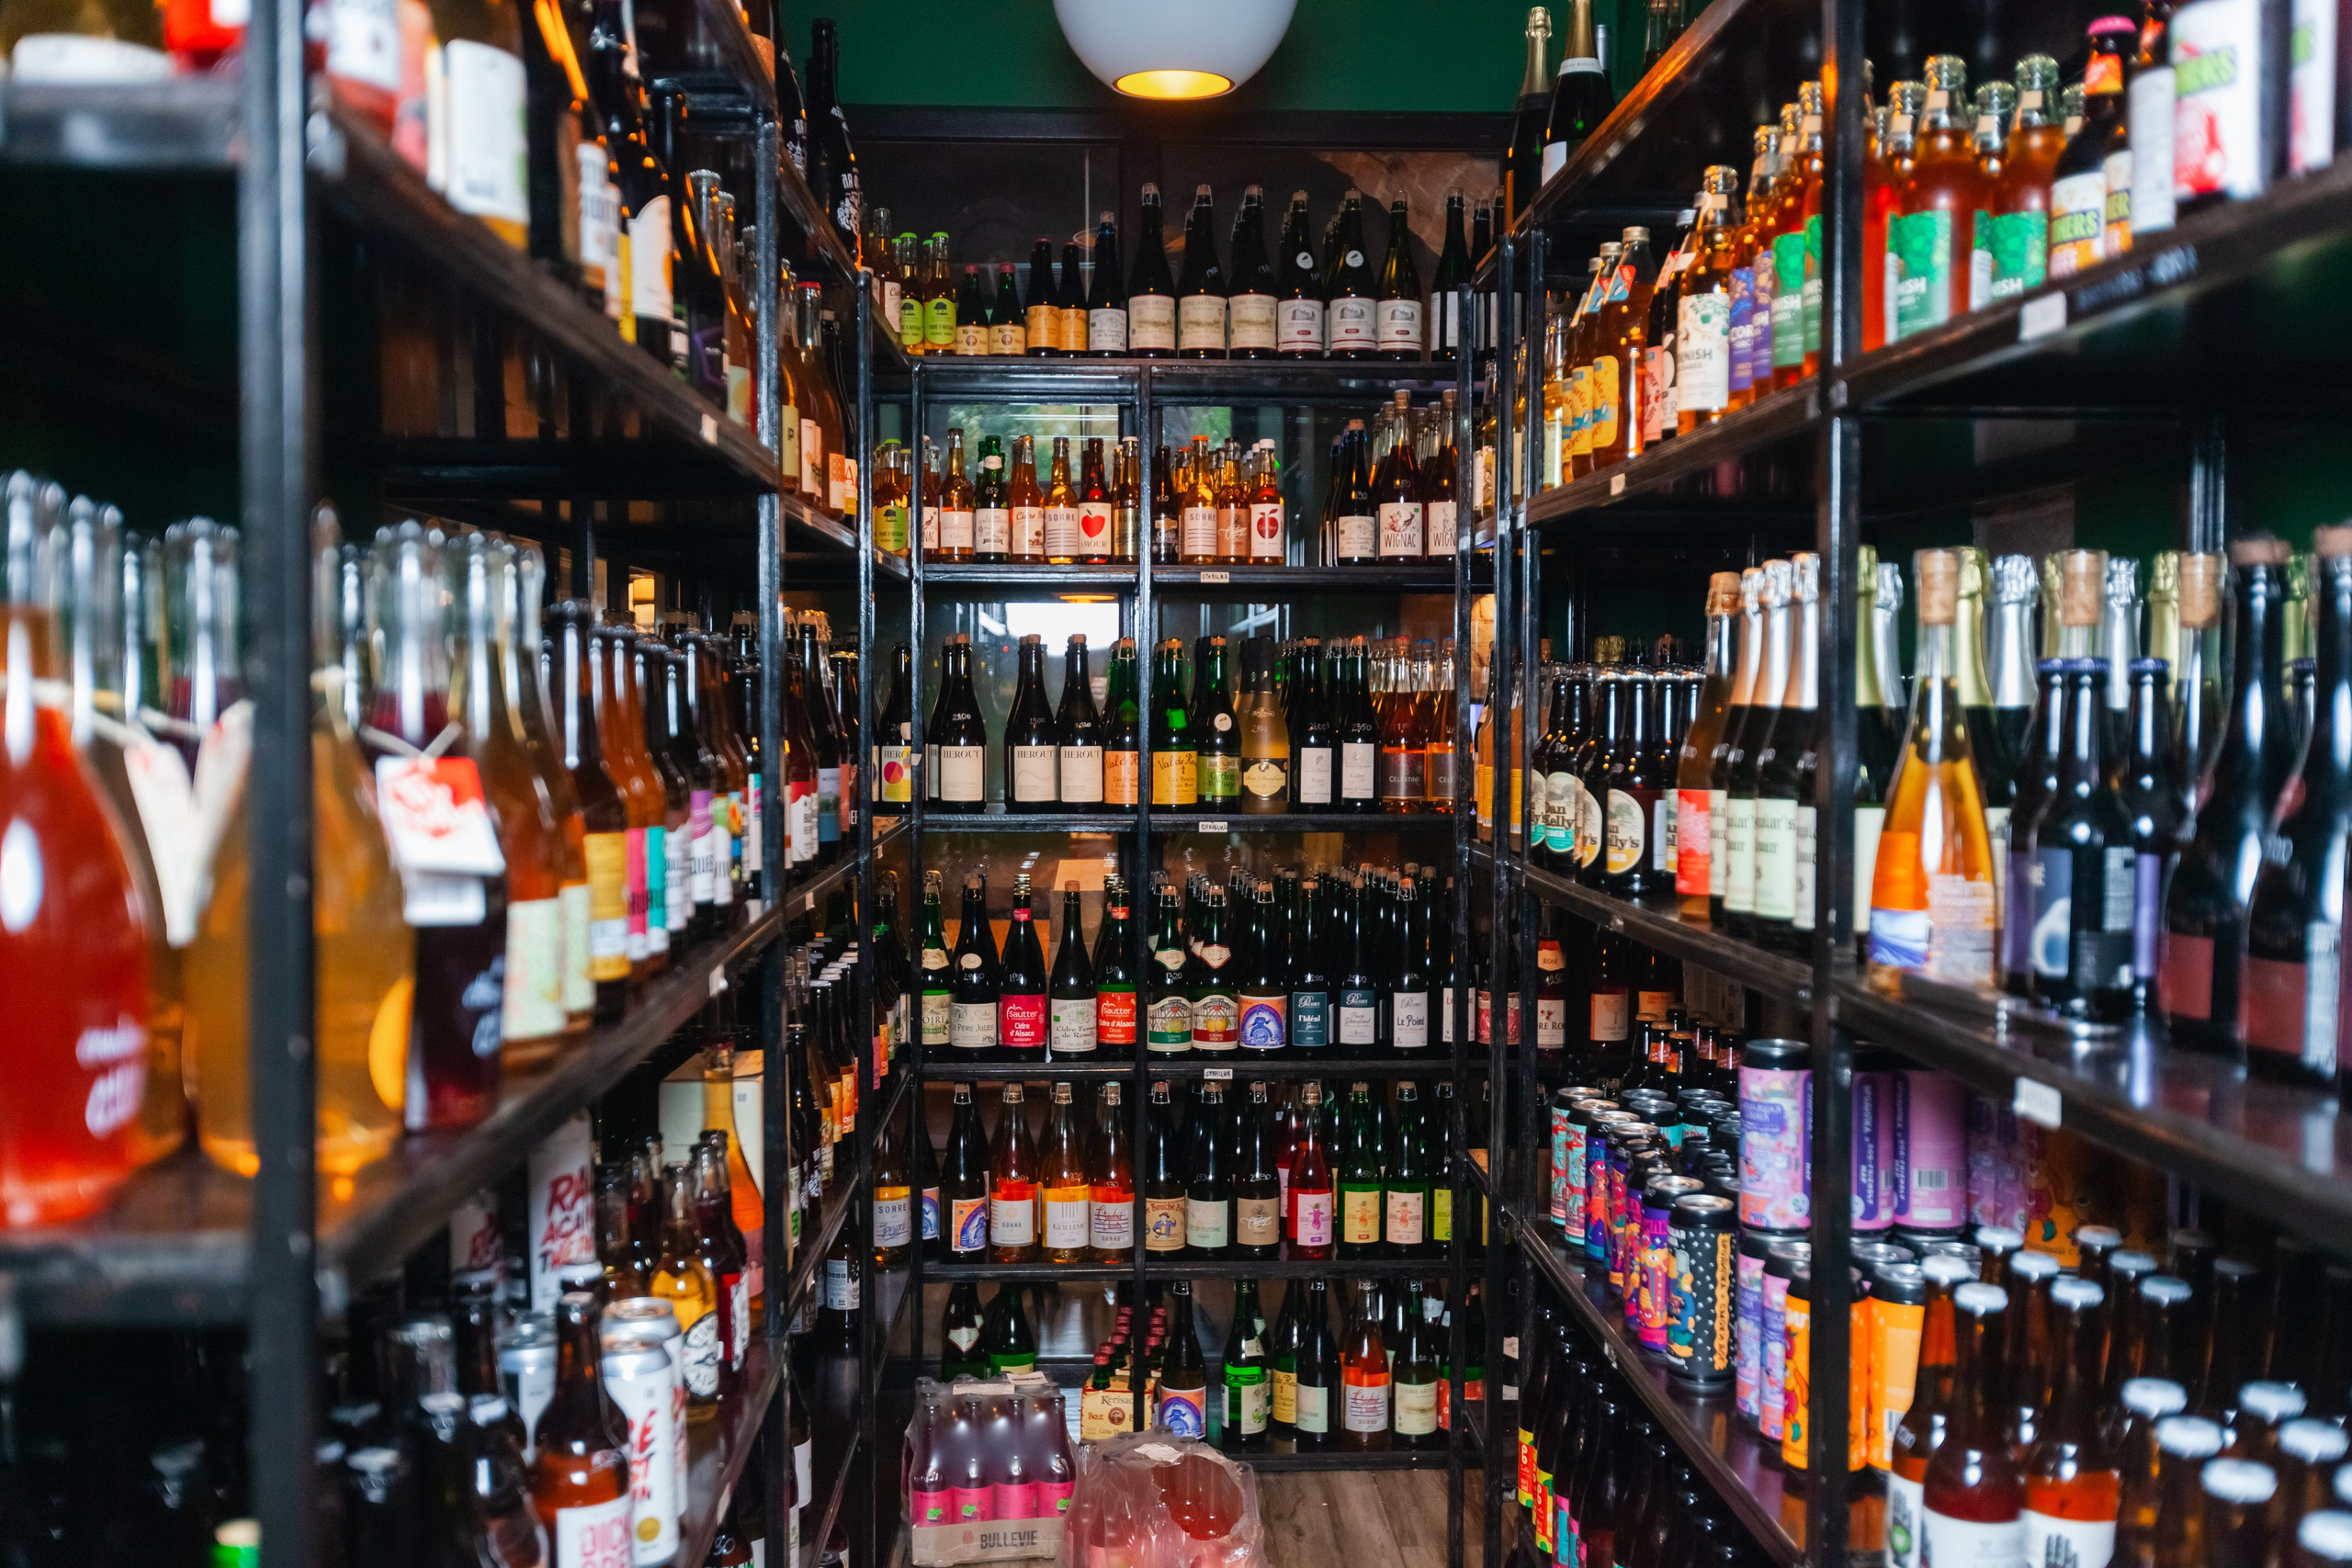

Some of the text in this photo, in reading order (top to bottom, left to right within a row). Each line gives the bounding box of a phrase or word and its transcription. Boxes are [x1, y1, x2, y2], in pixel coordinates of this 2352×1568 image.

[1048, 513, 1075, 522] SORRE
[1385, 533, 1416, 548] WIGNAC
[1351, 723, 1373, 732] 2350
[943, 750, 980, 759] HEROUT
[1017, 750, 1054, 759] HEROUT
[1064, 750, 1101, 759] HEROUT
[1106, 755, 1118, 770] Val
[1158, 755, 1173, 771] Val
[1175, 756, 1184, 765] de
[1210, 772, 1235, 781] Cidre
[1166, 972, 1182, 980] 1320
[1298, 1014, 1320, 1022] l'Idéal
[975, 1023, 995, 1032] JULES
[1111, 1019, 1136, 1027] d'Alsace
[878, 1202, 907, 1214] SORRE
[1101, 1395, 1134, 1406] Kerisac
[980, 1530, 1038, 1550] BULLEVIE
